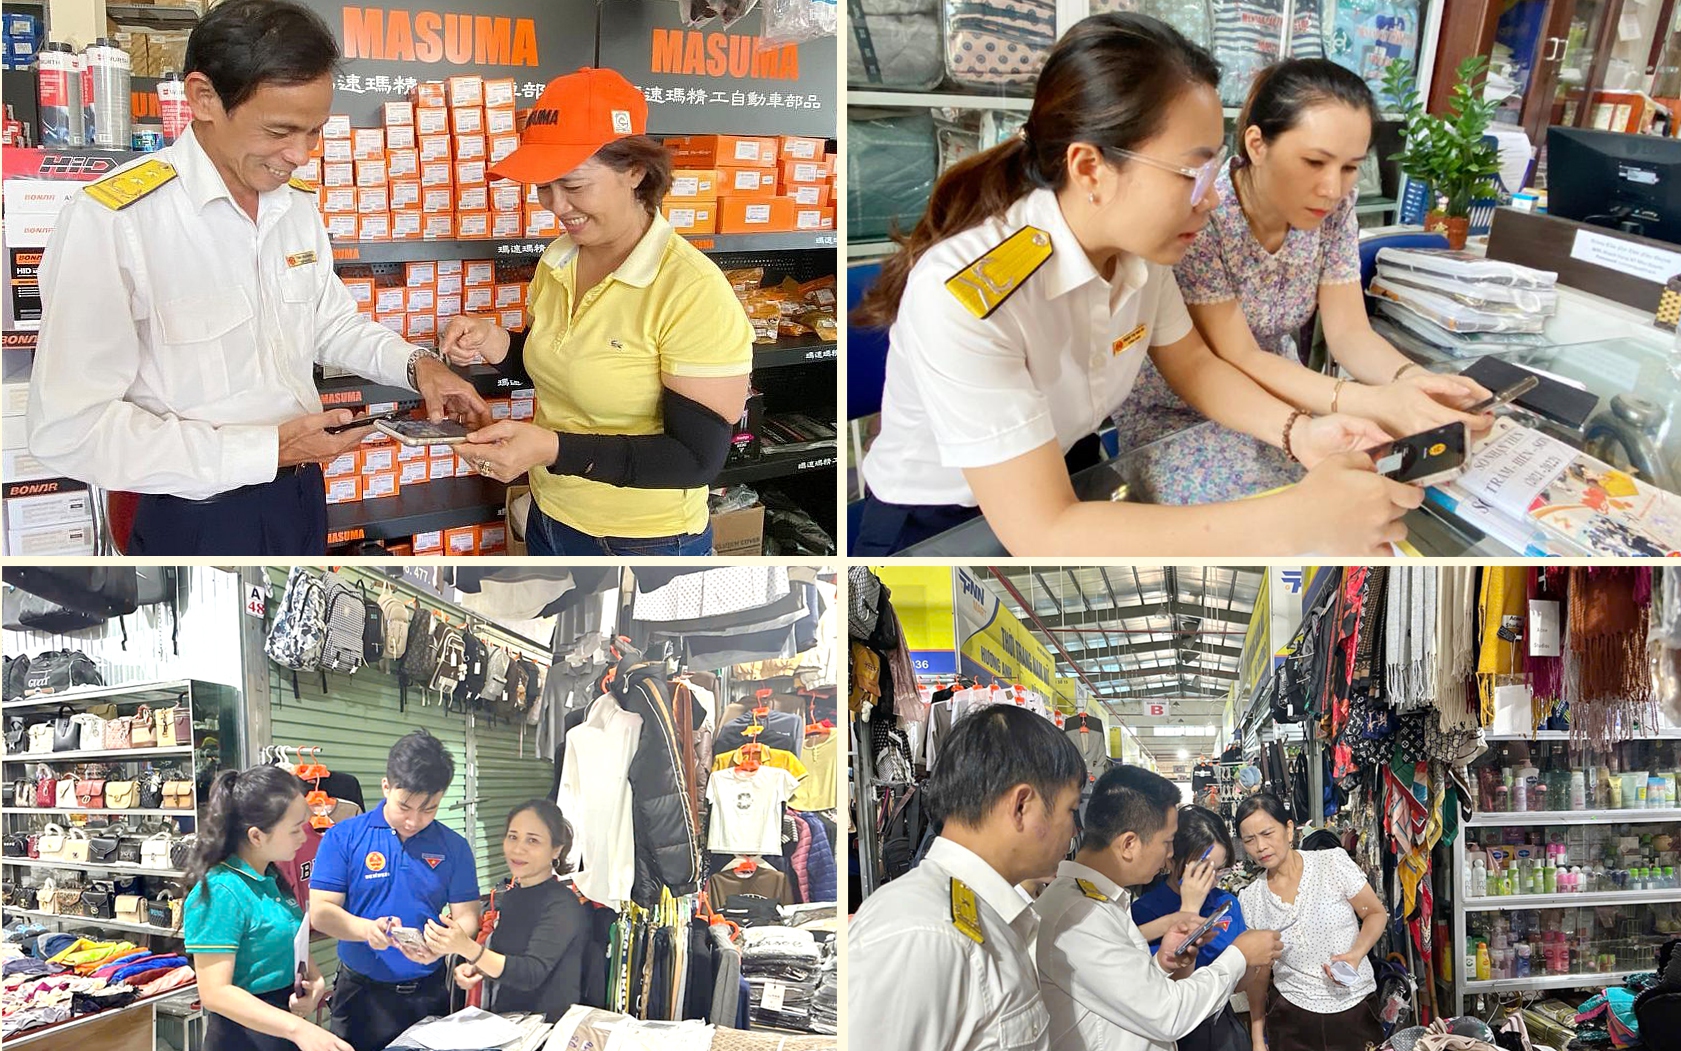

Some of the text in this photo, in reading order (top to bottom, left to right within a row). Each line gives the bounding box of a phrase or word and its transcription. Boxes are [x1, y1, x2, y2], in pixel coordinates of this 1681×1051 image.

[343, 6, 539, 67] MASUMA
[651, 28, 799, 81] MASUMA
[633, 86, 821, 109] 速瑪精工自動車部品
[40, 156, 118, 174] HID
[10, 483, 58, 496] BONAR
[251, 587, 261, 600] A
[248, 601, 265, 615] 48
[1151, 705, 1164, 715] B
